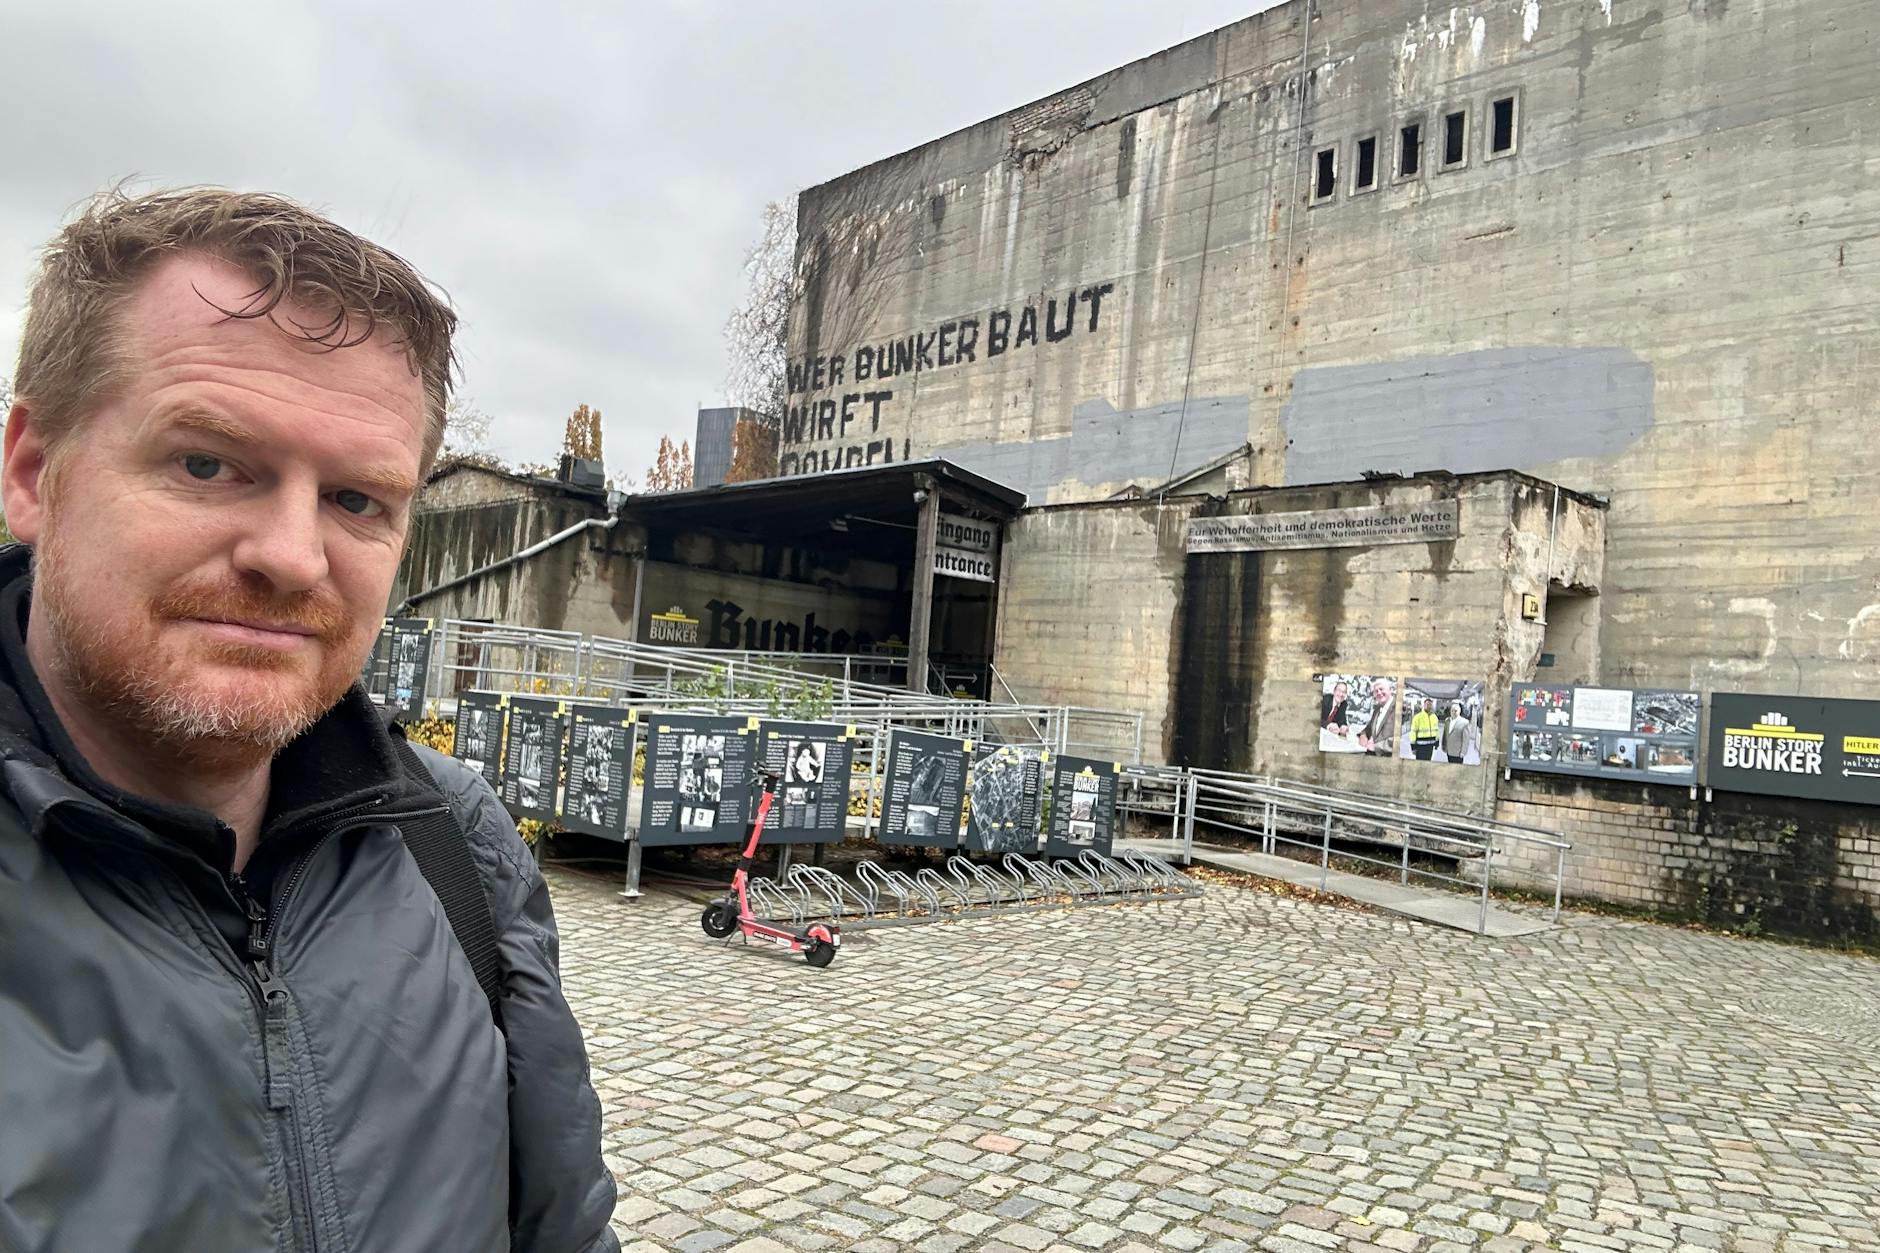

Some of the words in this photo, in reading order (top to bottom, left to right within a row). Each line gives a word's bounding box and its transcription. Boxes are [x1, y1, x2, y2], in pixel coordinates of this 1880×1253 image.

[786, 355, 846, 394] WER
[855, 319, 979, 383] BUNKER
[988, 283, 1114, 358] BAUT
[783, 390, 893, 444] WIRFT
[937, 519, 991, 548] ingang
[1208, 523, 1281, 536] Weltoffenheit
[1285, 521, 1306, 532] und
[1310, 515, 1406, 531] demokratische
[1410, 512, 1451, 524] Werte
[1331, 528, 1398, 538] Nationalismus
[1401, 525, 1418, 533] und
[1421, 523, 1451, 532] Hetze
[935, 552, 991, 577] ntrance
[650, 626, 698, 644] BUNKER
[677, 622, 699, 631] STORY
[1724, 735, 1773, 750] BERLIN
[1777, 739, 1825, 754] STORY
[1846, 741, 1879, 750] HITLER
[1723, 746, 1822, 775] BUNKER
